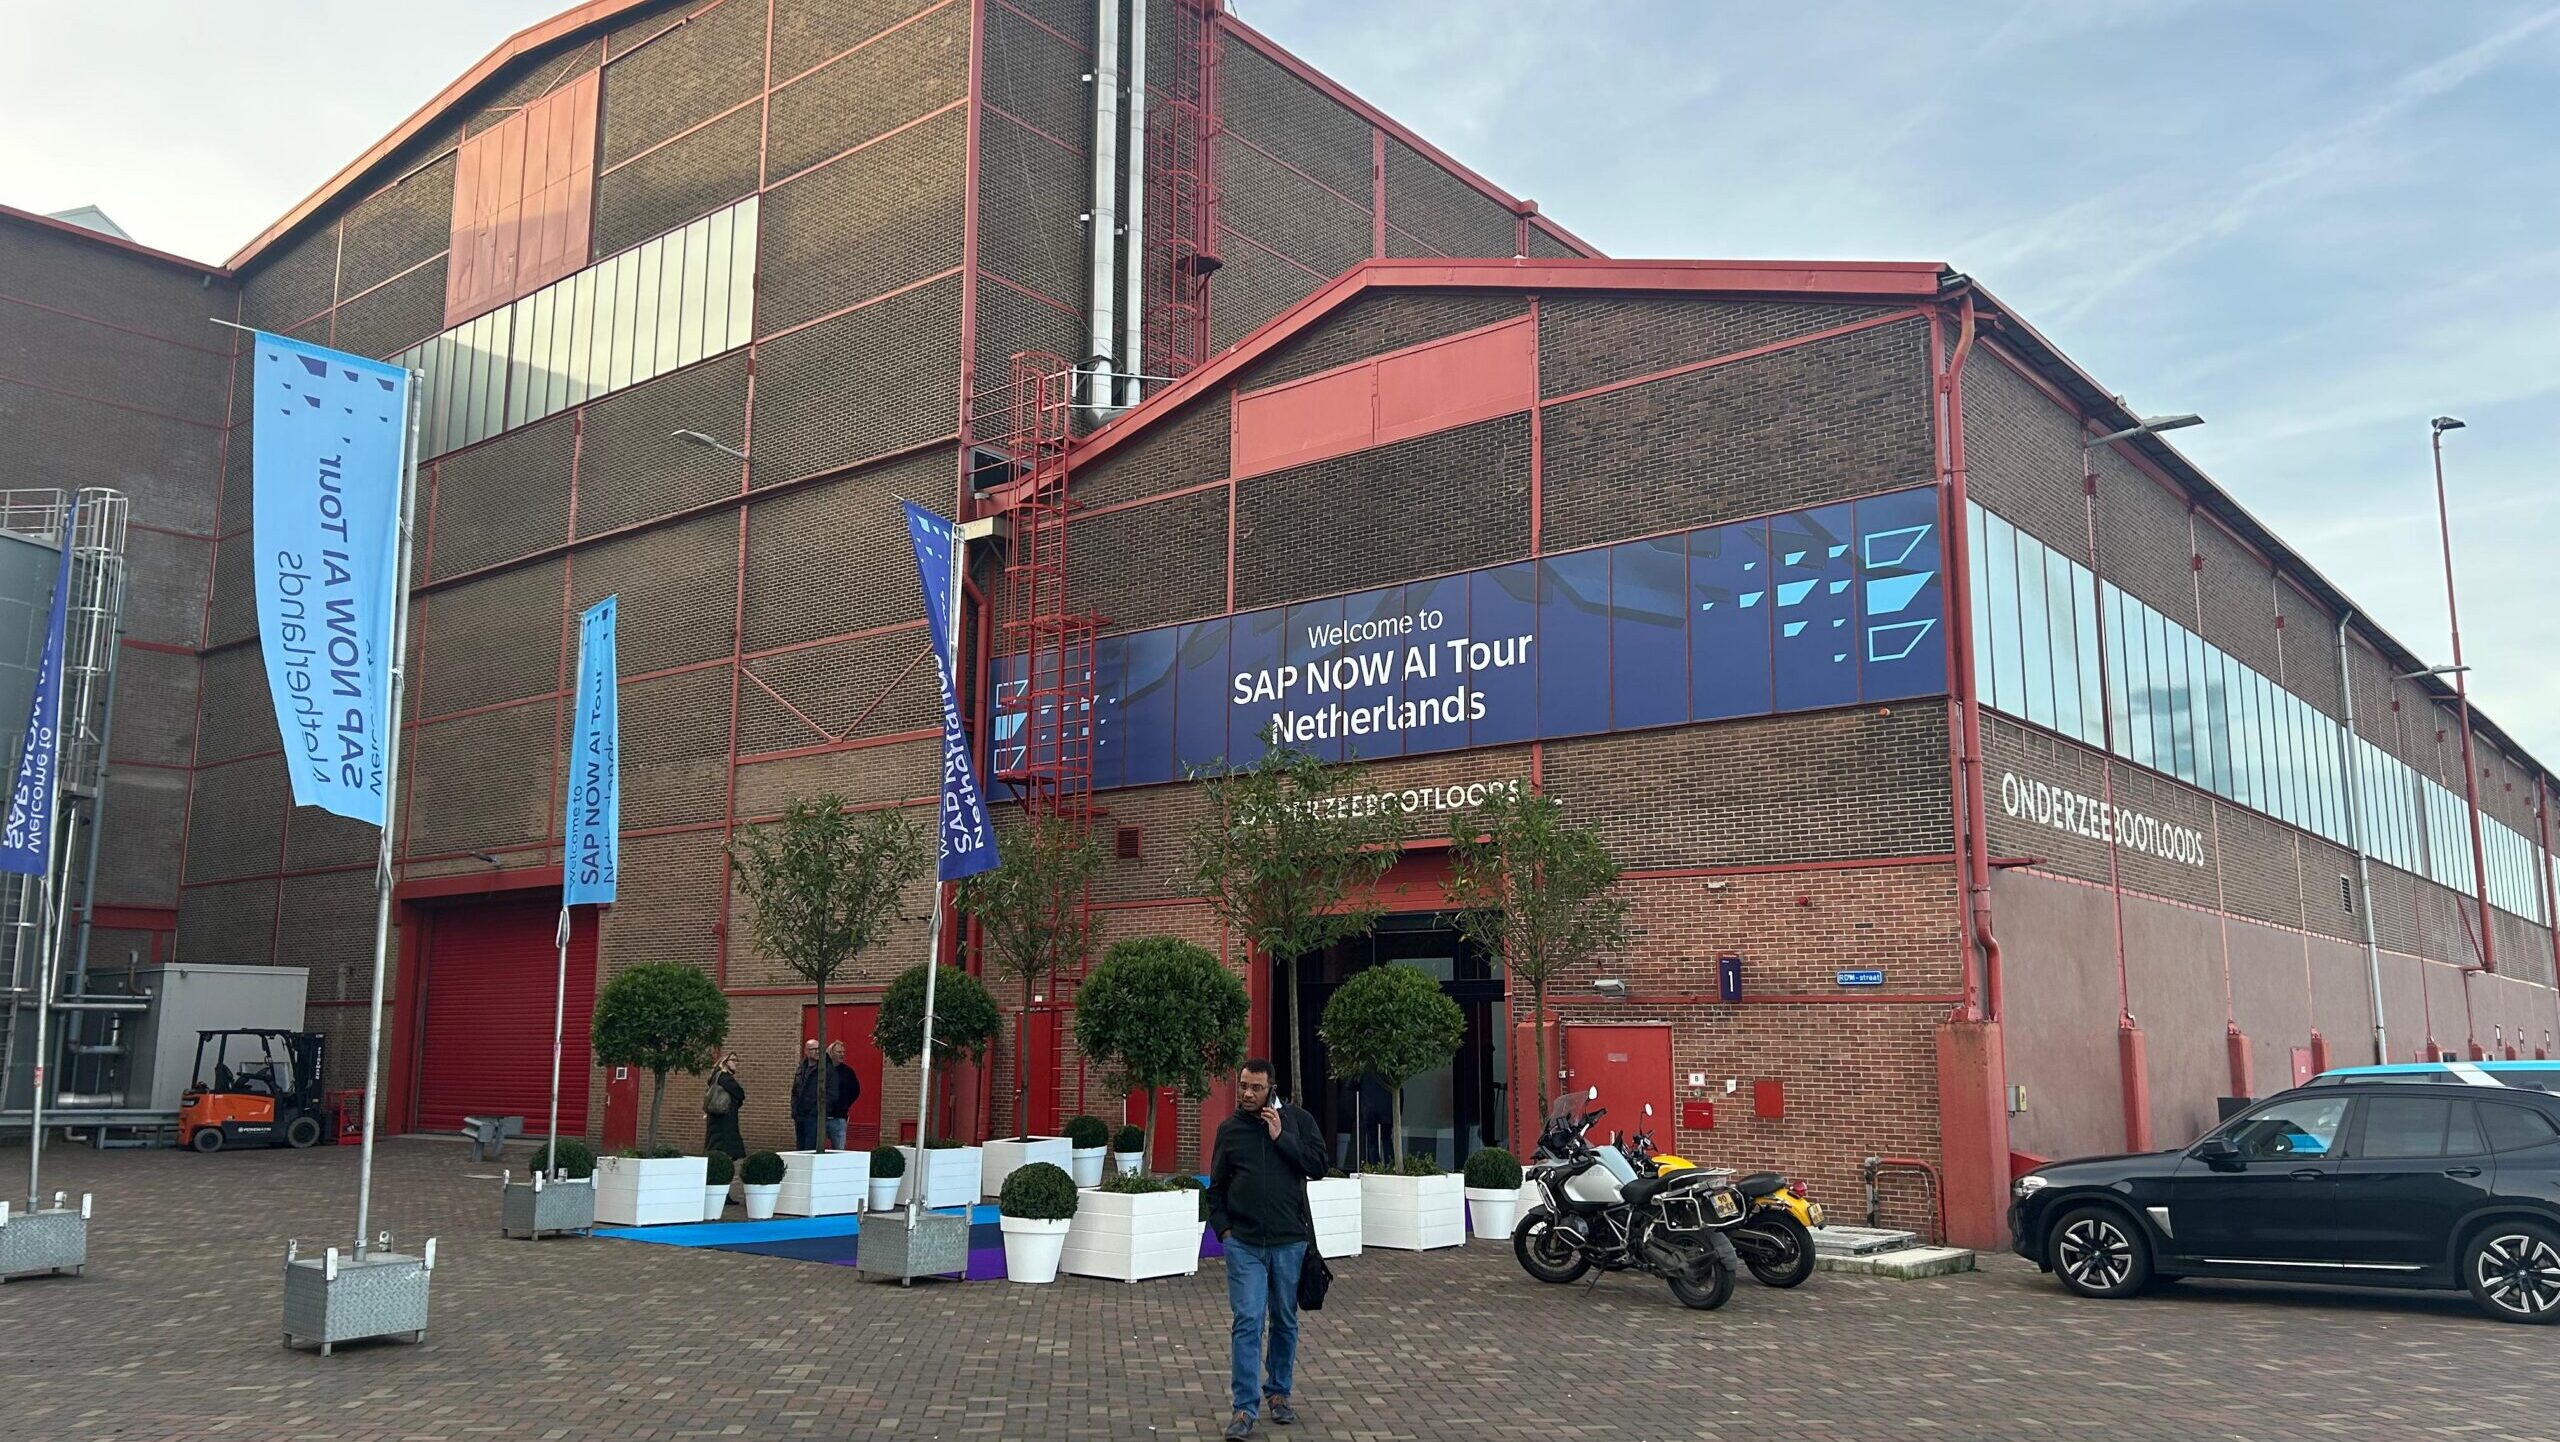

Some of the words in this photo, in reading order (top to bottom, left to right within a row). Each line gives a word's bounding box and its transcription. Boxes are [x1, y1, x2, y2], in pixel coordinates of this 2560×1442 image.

[1307, 612, 1413, 649] Welcome
[1419, 608, 1444, 632] to
[1232, 665, 1299, 706] SAP
[1306, 649, 1395, 696] NOW
[1400, 643, 1437, 682] AI
[1446, 633, 1533, 675] Tour
[588, 729, 602, 756] AI
[1271, 685, 1487, 745] Netherlands
[585, 762, 600, 825] NOW
[2002, 772, 2204, 867] ONDERZEEBOOTLOODS
[581, 833, 600, 886] SAP
[1728, 970, 1734, 993] 1
